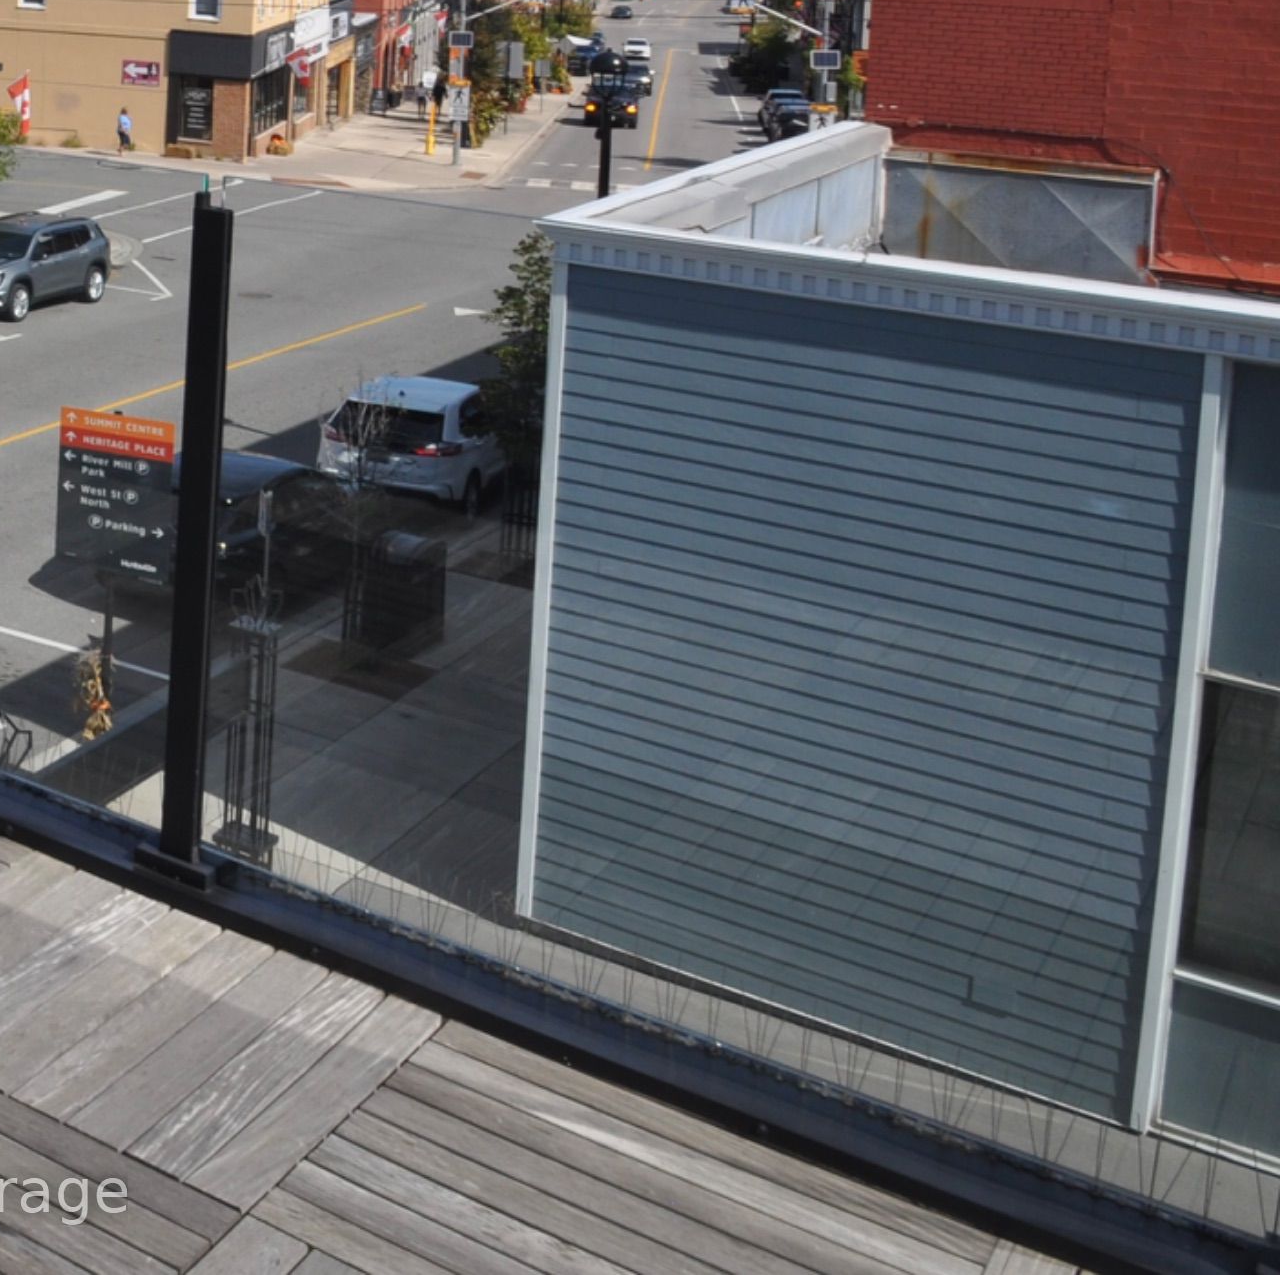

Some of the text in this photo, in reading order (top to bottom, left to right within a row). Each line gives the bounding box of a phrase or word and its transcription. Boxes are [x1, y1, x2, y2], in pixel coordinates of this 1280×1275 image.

[84, 416, 164, 436] SUMMIT CENTRE
[82, 435, 166, 457] HERITAGE PLACE
[81, 454, 109, 466] River
[113, 459, 133, 471] Mill
[81, 466, 105, 477] Park
[81, 485, 107, 497] West
[110, 489, 121, 500] St
[80, 496, 110, 509] North
[105, 519, 146, 537] Parking
